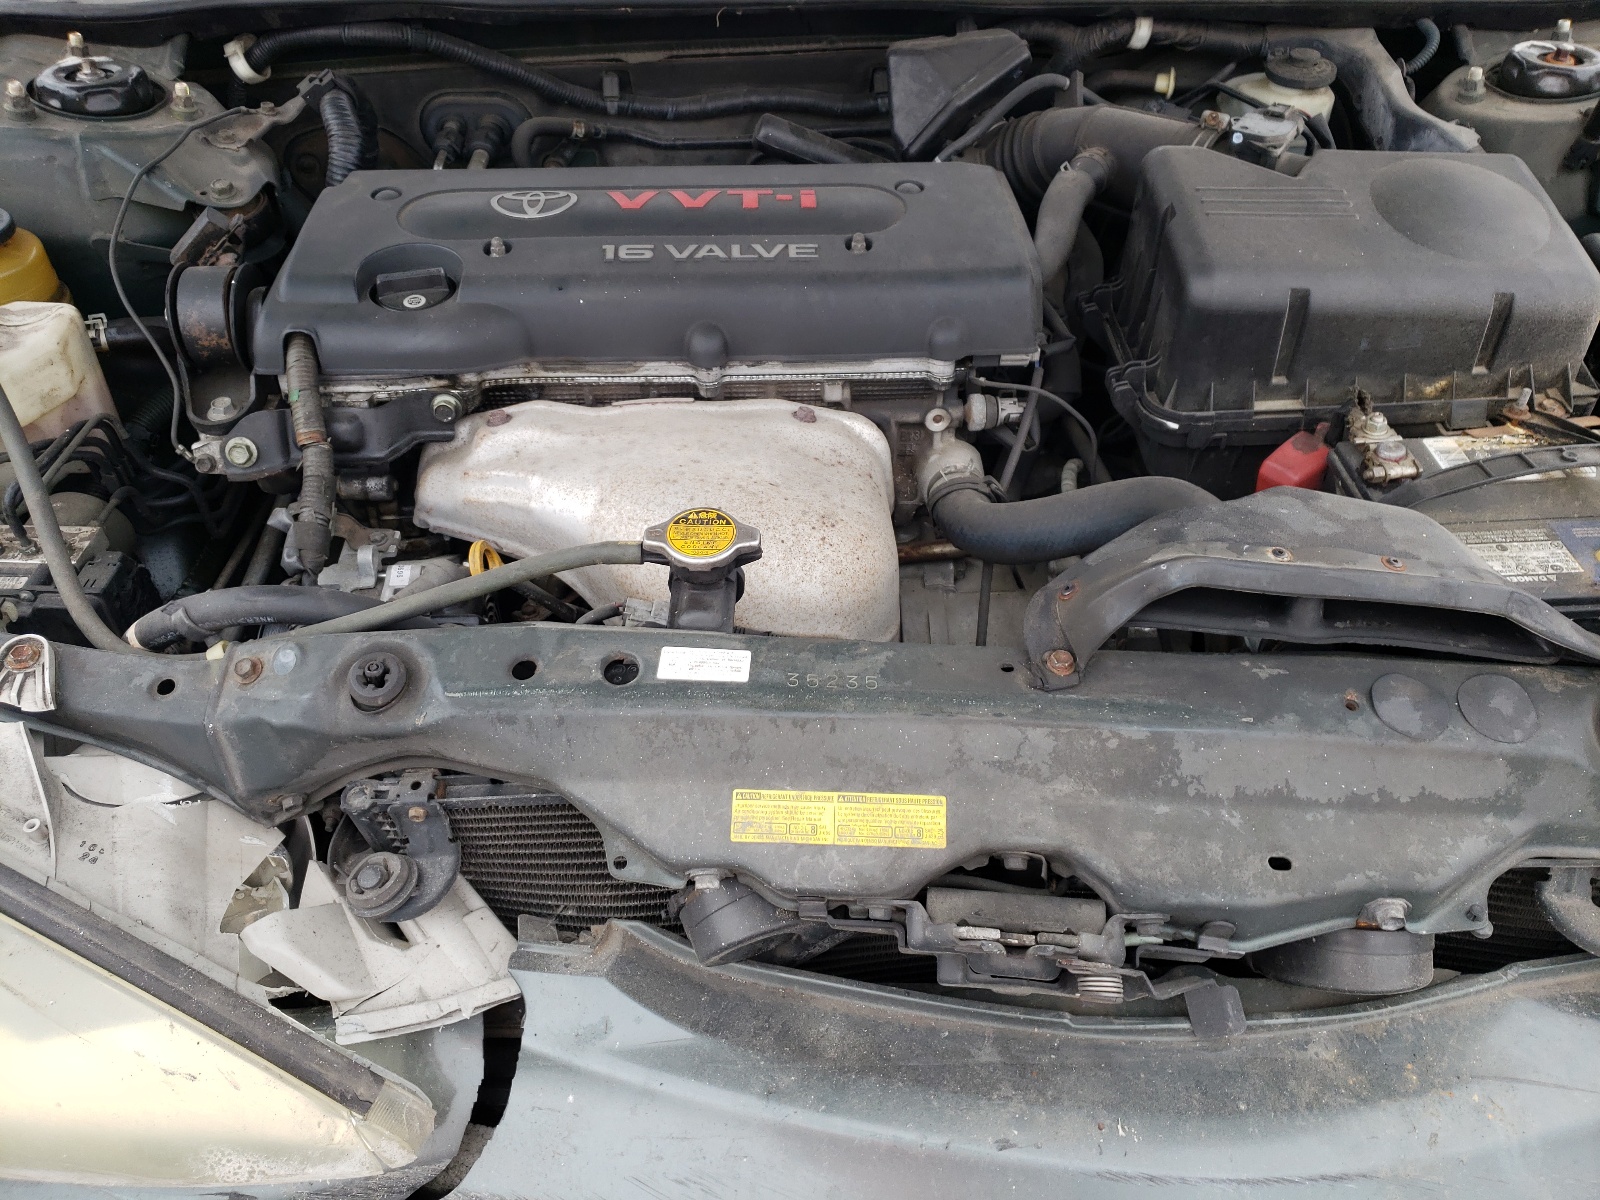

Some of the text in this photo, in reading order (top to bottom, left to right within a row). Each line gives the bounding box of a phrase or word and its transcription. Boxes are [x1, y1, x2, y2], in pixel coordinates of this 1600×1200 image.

[606, 189, 817, 209] VVT-i
[602, 243, 819, 260] 16 VALVE
[787, 672, 878, 690] 35235
